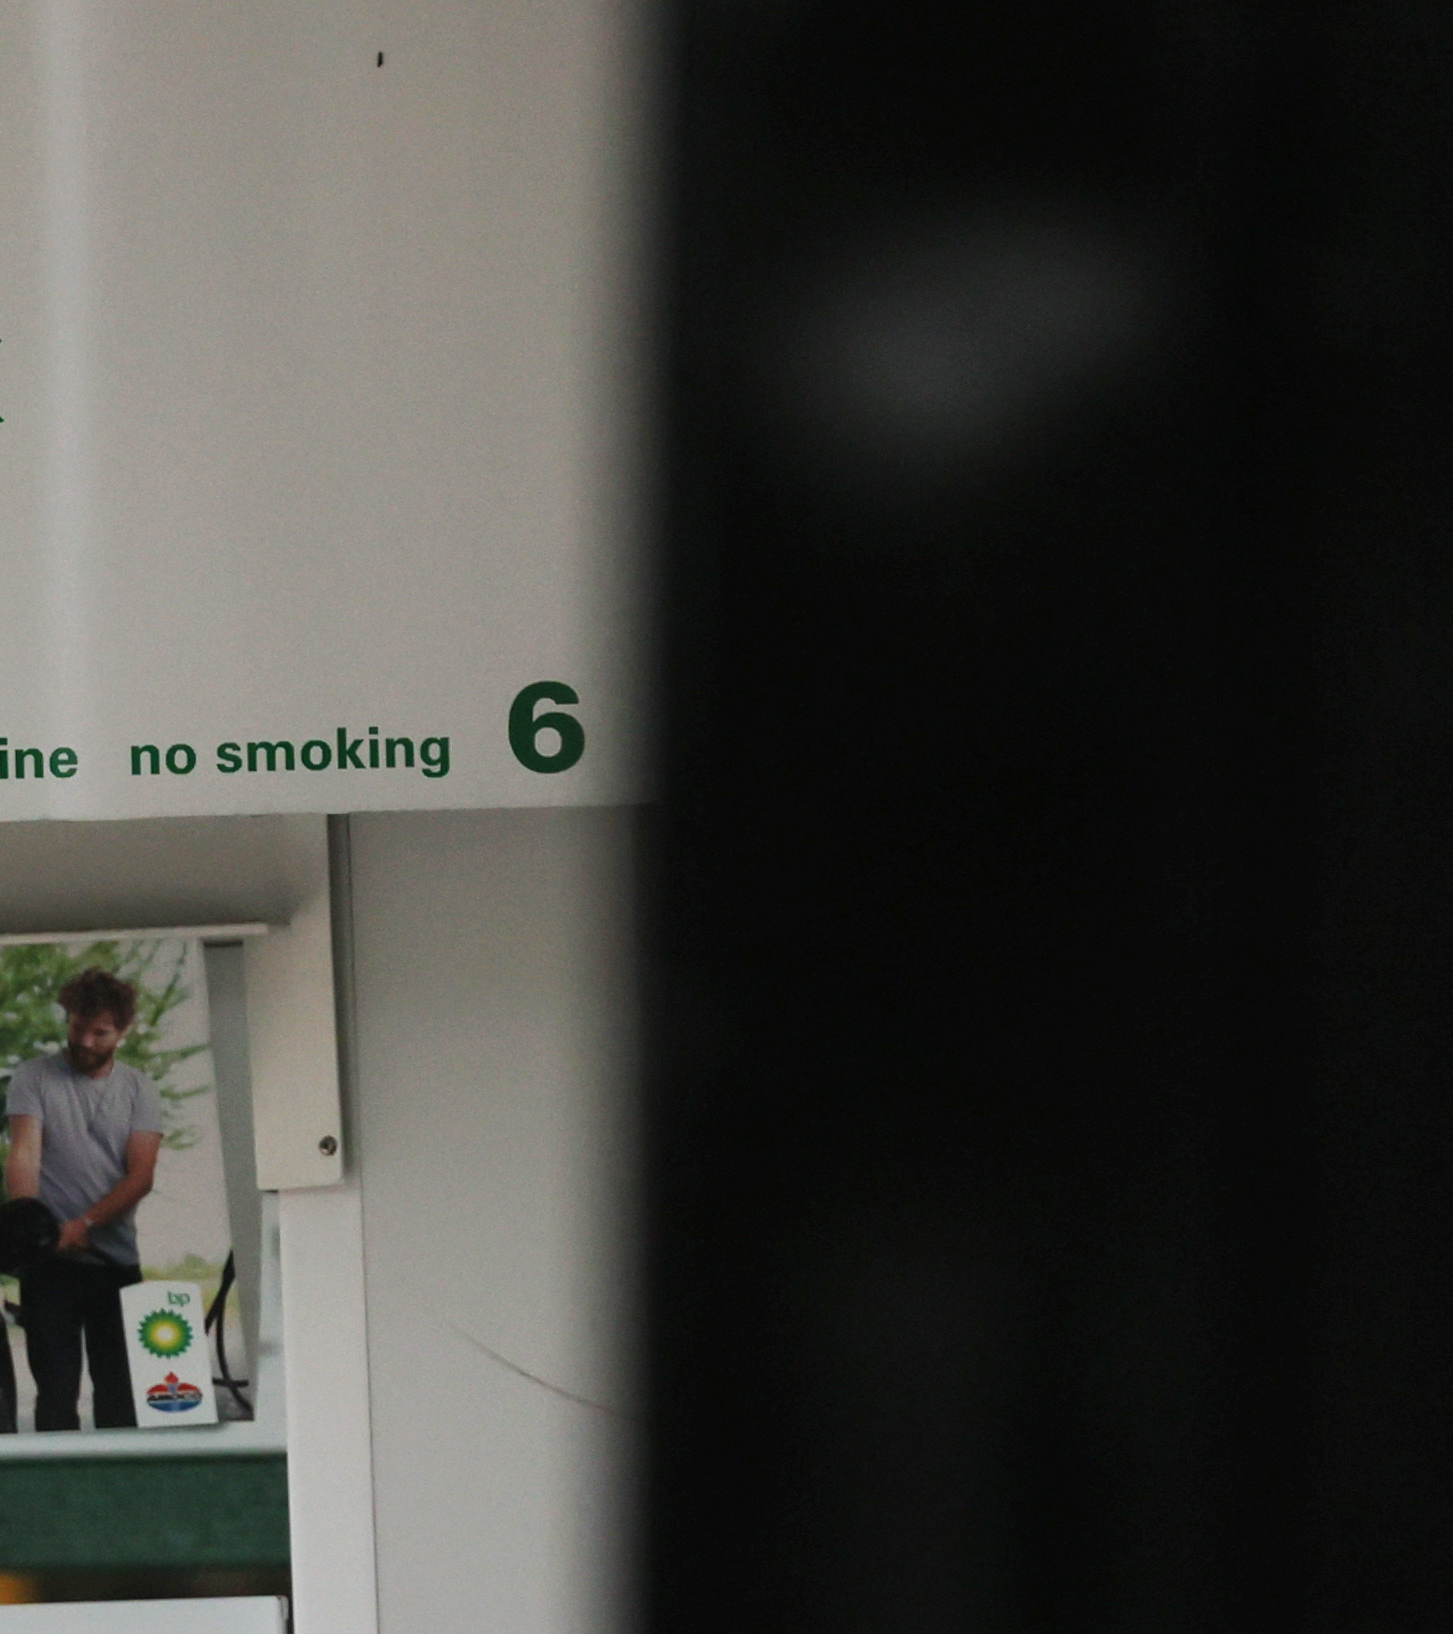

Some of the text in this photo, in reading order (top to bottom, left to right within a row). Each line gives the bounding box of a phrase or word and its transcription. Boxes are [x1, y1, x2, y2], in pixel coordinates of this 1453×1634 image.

[130, 725, 453, 779] no smoking
[507, 679, 586, 775] 6
